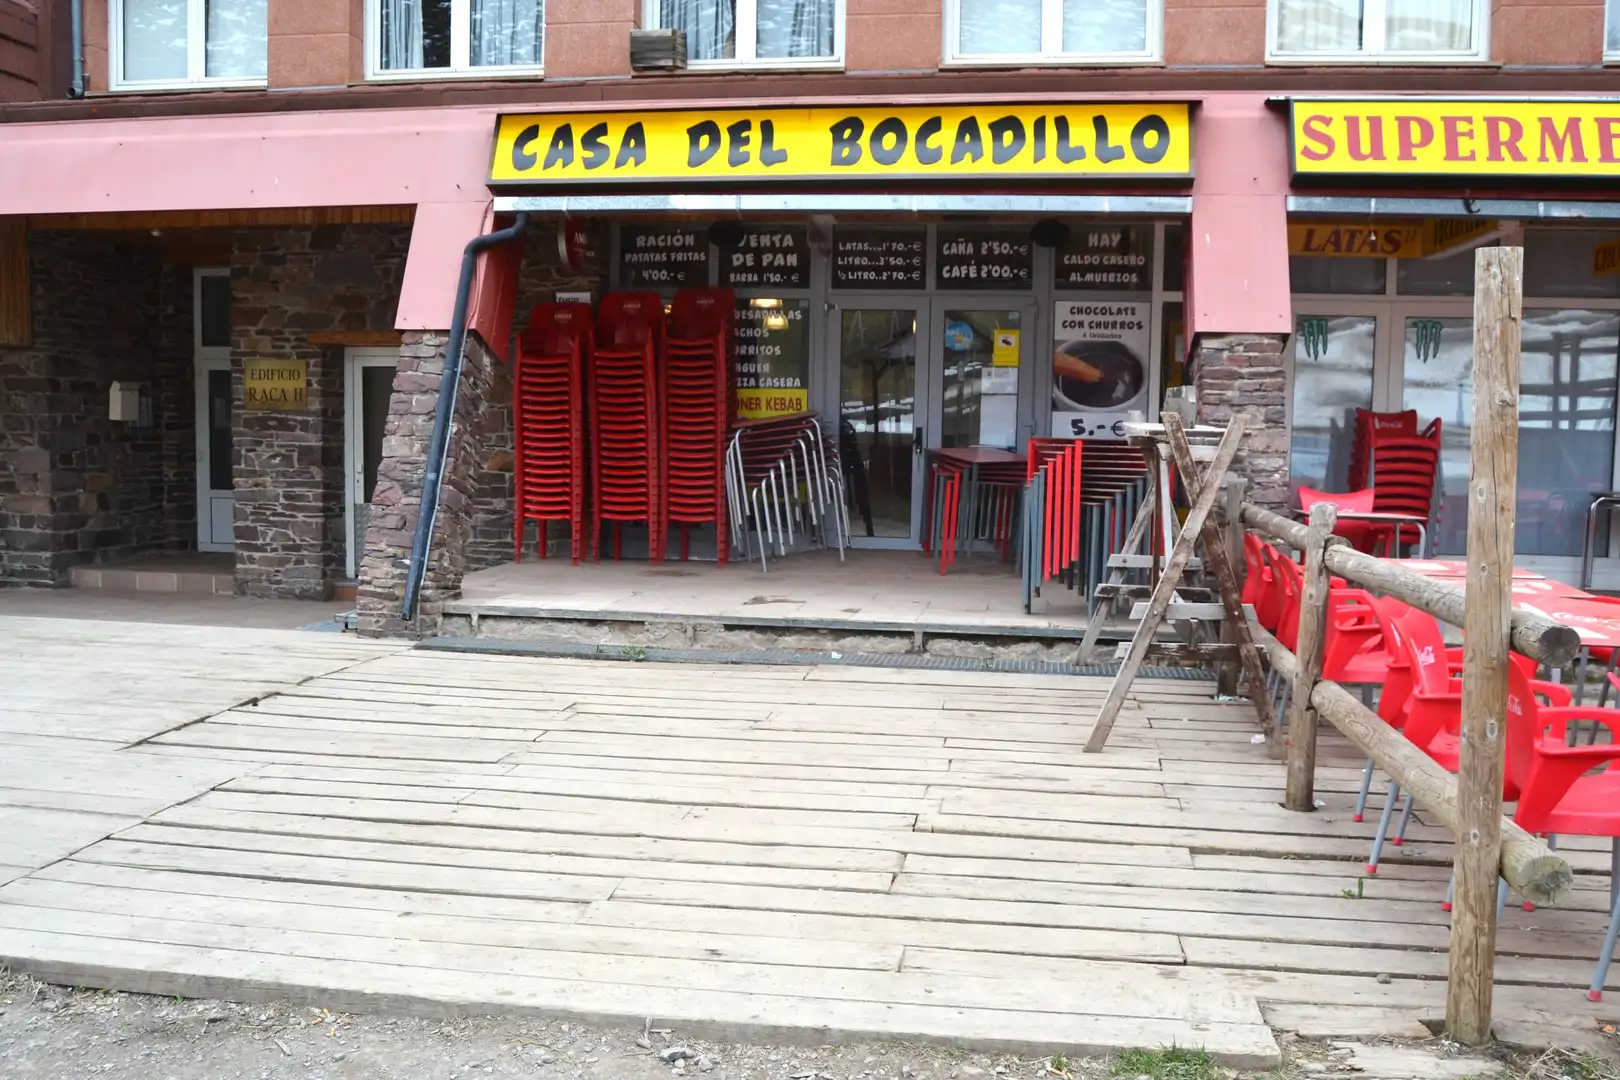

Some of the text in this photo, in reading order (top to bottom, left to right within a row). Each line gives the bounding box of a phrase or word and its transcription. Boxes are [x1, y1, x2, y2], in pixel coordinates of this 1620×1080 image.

[512, 114, 1170, 171] CASA DEL BOCADILLO
[1300, 114, 1620, 163] SUPERME
[637, 229, 695, 248] RACIÓN
[1088, 232, 1122, 247] HAY
[942, 238, 974, 256] CAÑA
[625, 251, 706, 263] PATATAS FRITAS
[732, 252, 798, 267] DE PAN
[1063, 254, 1145, 265] CALDO CASERO
[942, 260, 977, 279] CAFÉ
[729, 272, 758, 283] BARRA
[1069, 272, 1138, 283] ALMUERZOS
[1069, 306, 1136, 316] CHOCOLATE
[1062, 319, 1143, 330] CON CHURROS
[250, 368, 300, 381] EDIFICIO
[758, 377, 801, 388] CASERA
[248, 387, 289, 402] RACA
[736, 396, 803, 411] NER KEBAB
